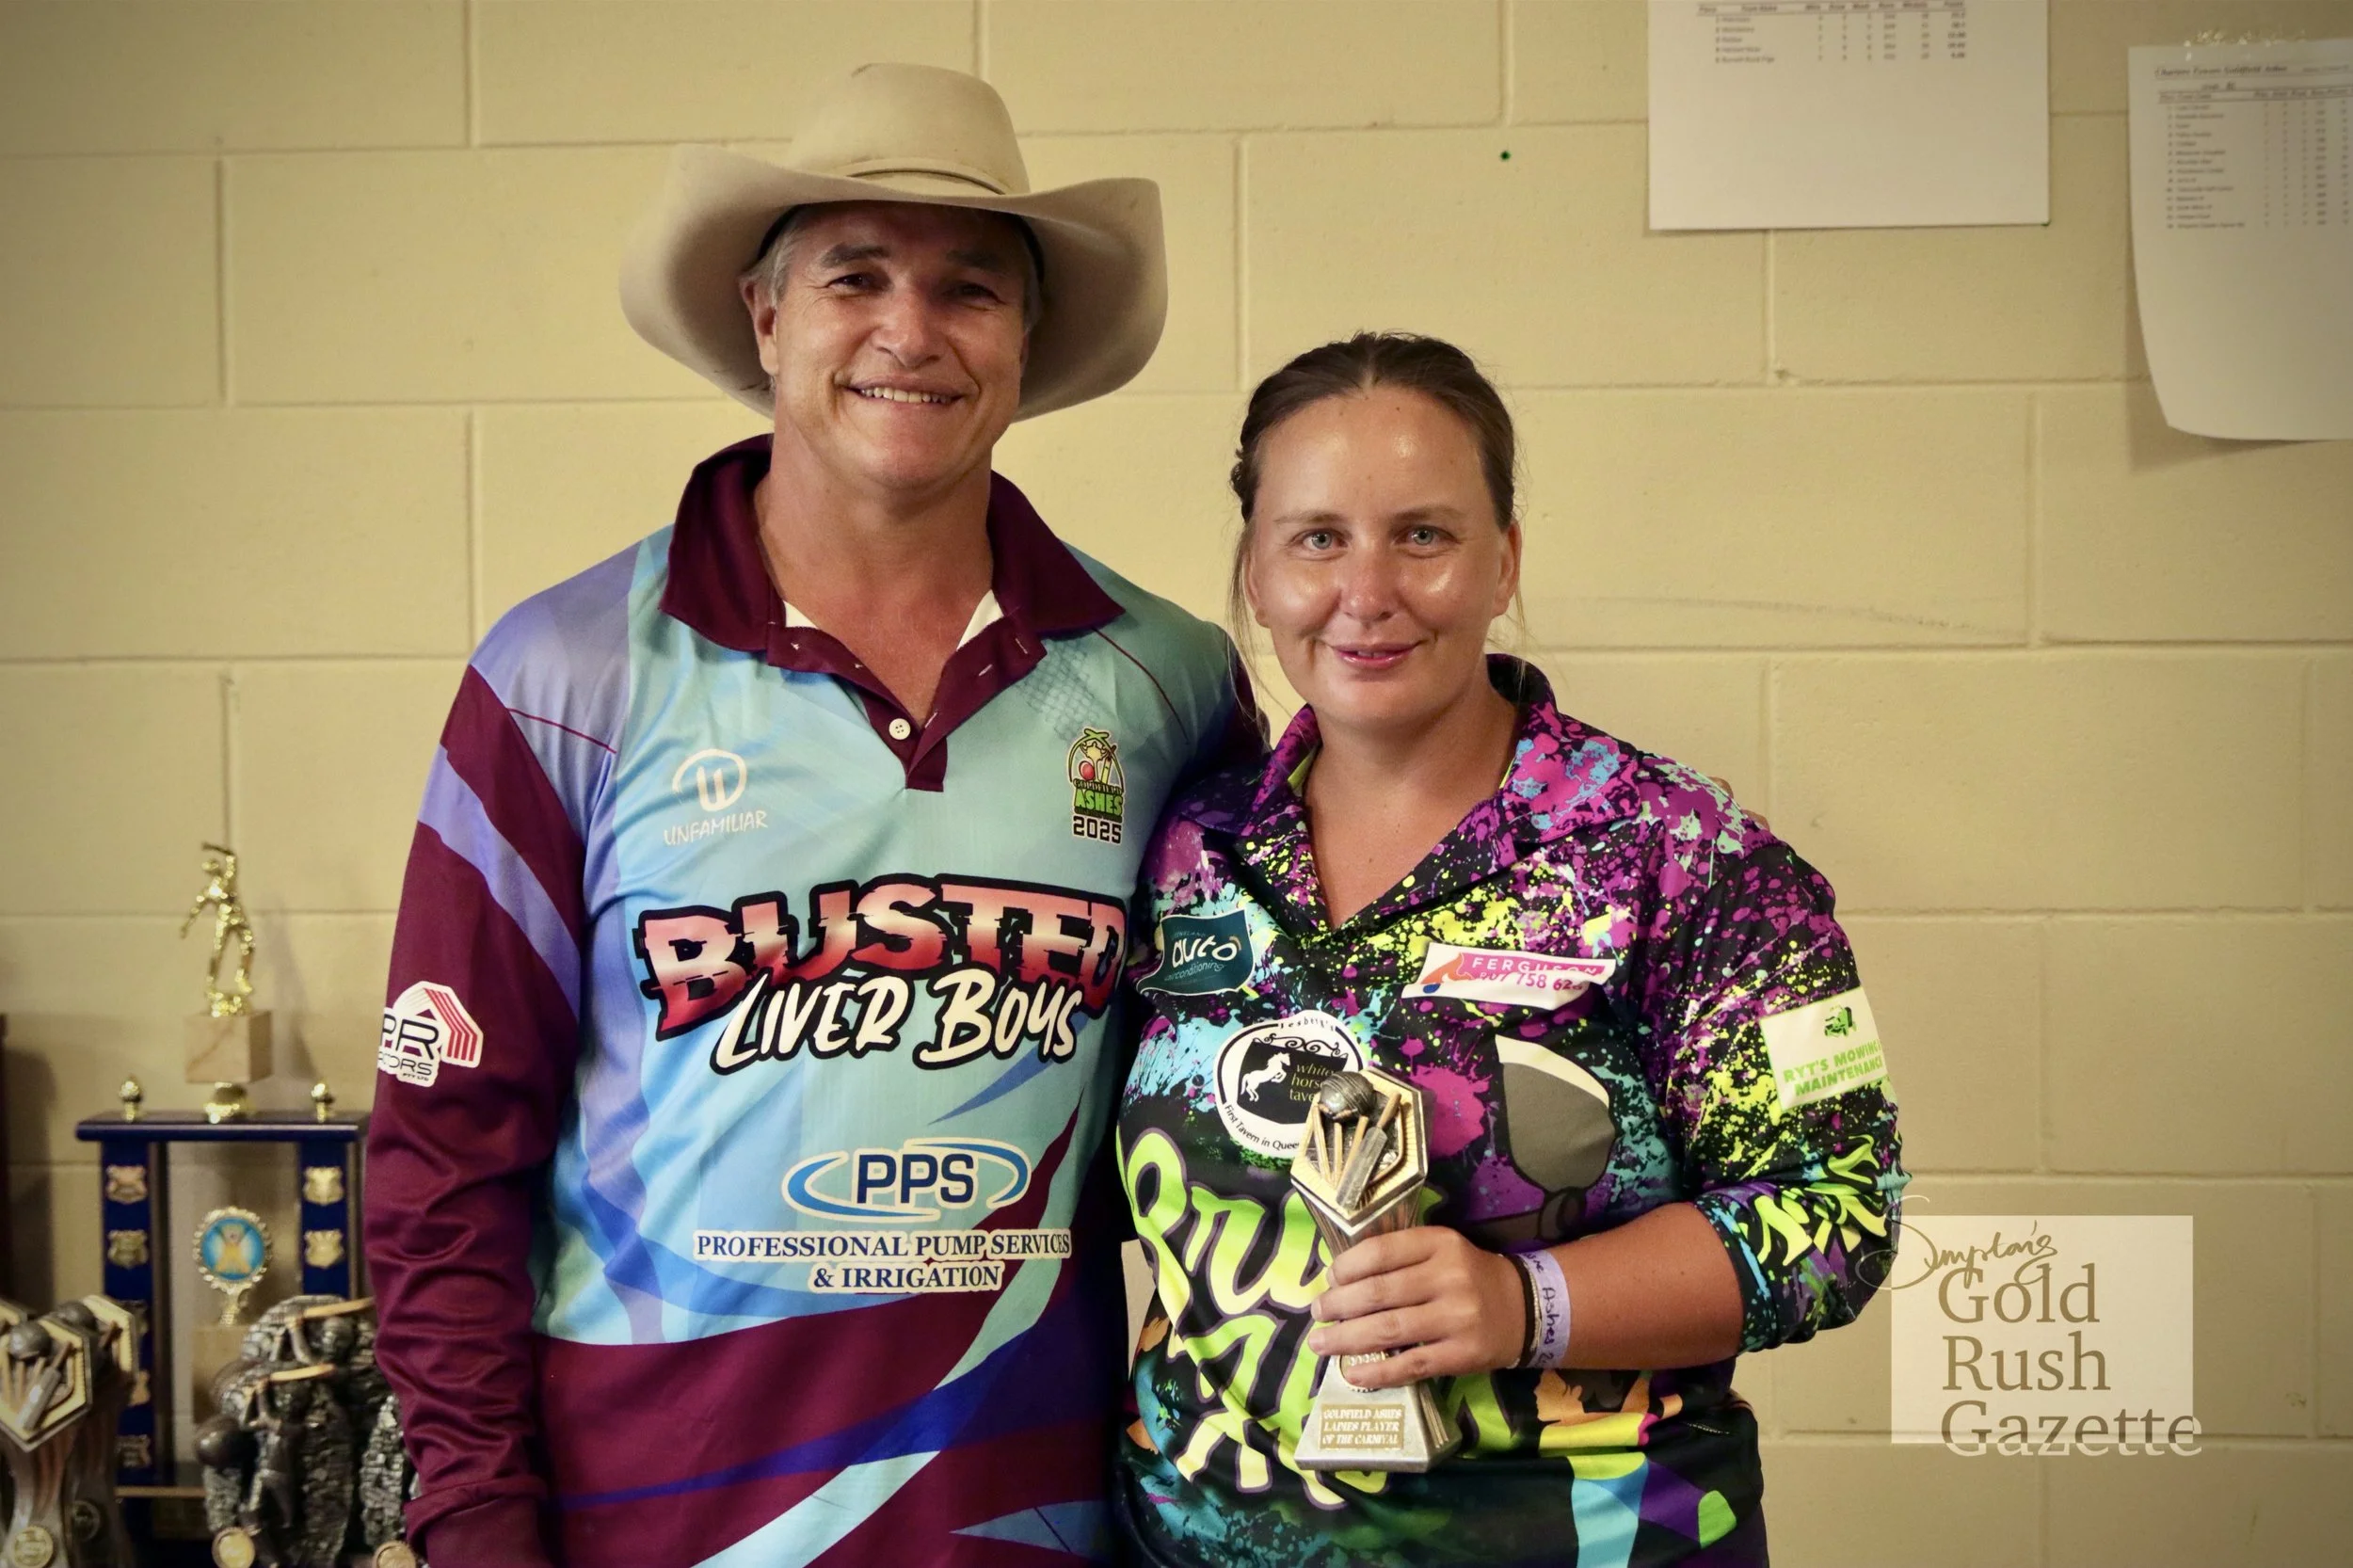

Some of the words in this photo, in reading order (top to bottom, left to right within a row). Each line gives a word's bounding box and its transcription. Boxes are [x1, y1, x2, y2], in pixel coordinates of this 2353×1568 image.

[1074, 788, 1124, 817] ASHES
[663, 809, 769, 846] UNFAMILIAR
[1072, 815, 1122, 844] 2025
[638, 877, 1128, 1035] BUSTED
[1171, 935, 1238, 968] auto
[1290, 1072, 1322, 1090] hors
[1783, 1059, 1830, 1083] RYT'S
[1225, 1104, 1239, 1124] First
[1235, 1121, 1260, 1144] Tavern
[1260, 1136, 1271, 1148] in
[1272, 1140, 1300, 1152] Quee
[856, 1153, 975, 1205] PPS
[696, 1235, 909, 1258] PROFESSIONAL
[914, 1235, 987, 1257] PUMP
[990, 1232, 1071, 1256] SERVICES
[813, 1268, 835, 1288] &
[840, 1265, 1000, 1289] IRRIGATION
[1541, 1286, 1561, 1345] Ashes
[1322, 1408, 1372, 1420] GOLDFIELD
[1372, 1408, 1402, 1420] ASHES
[1323, 1421, 1360, 1432] LADIES
[1360, 1421, 1401, 1432] PLAYER
[1336, 1433, 1354, 1445] THE
[1354, 1433, 1400, 1445] CARNIVAL
